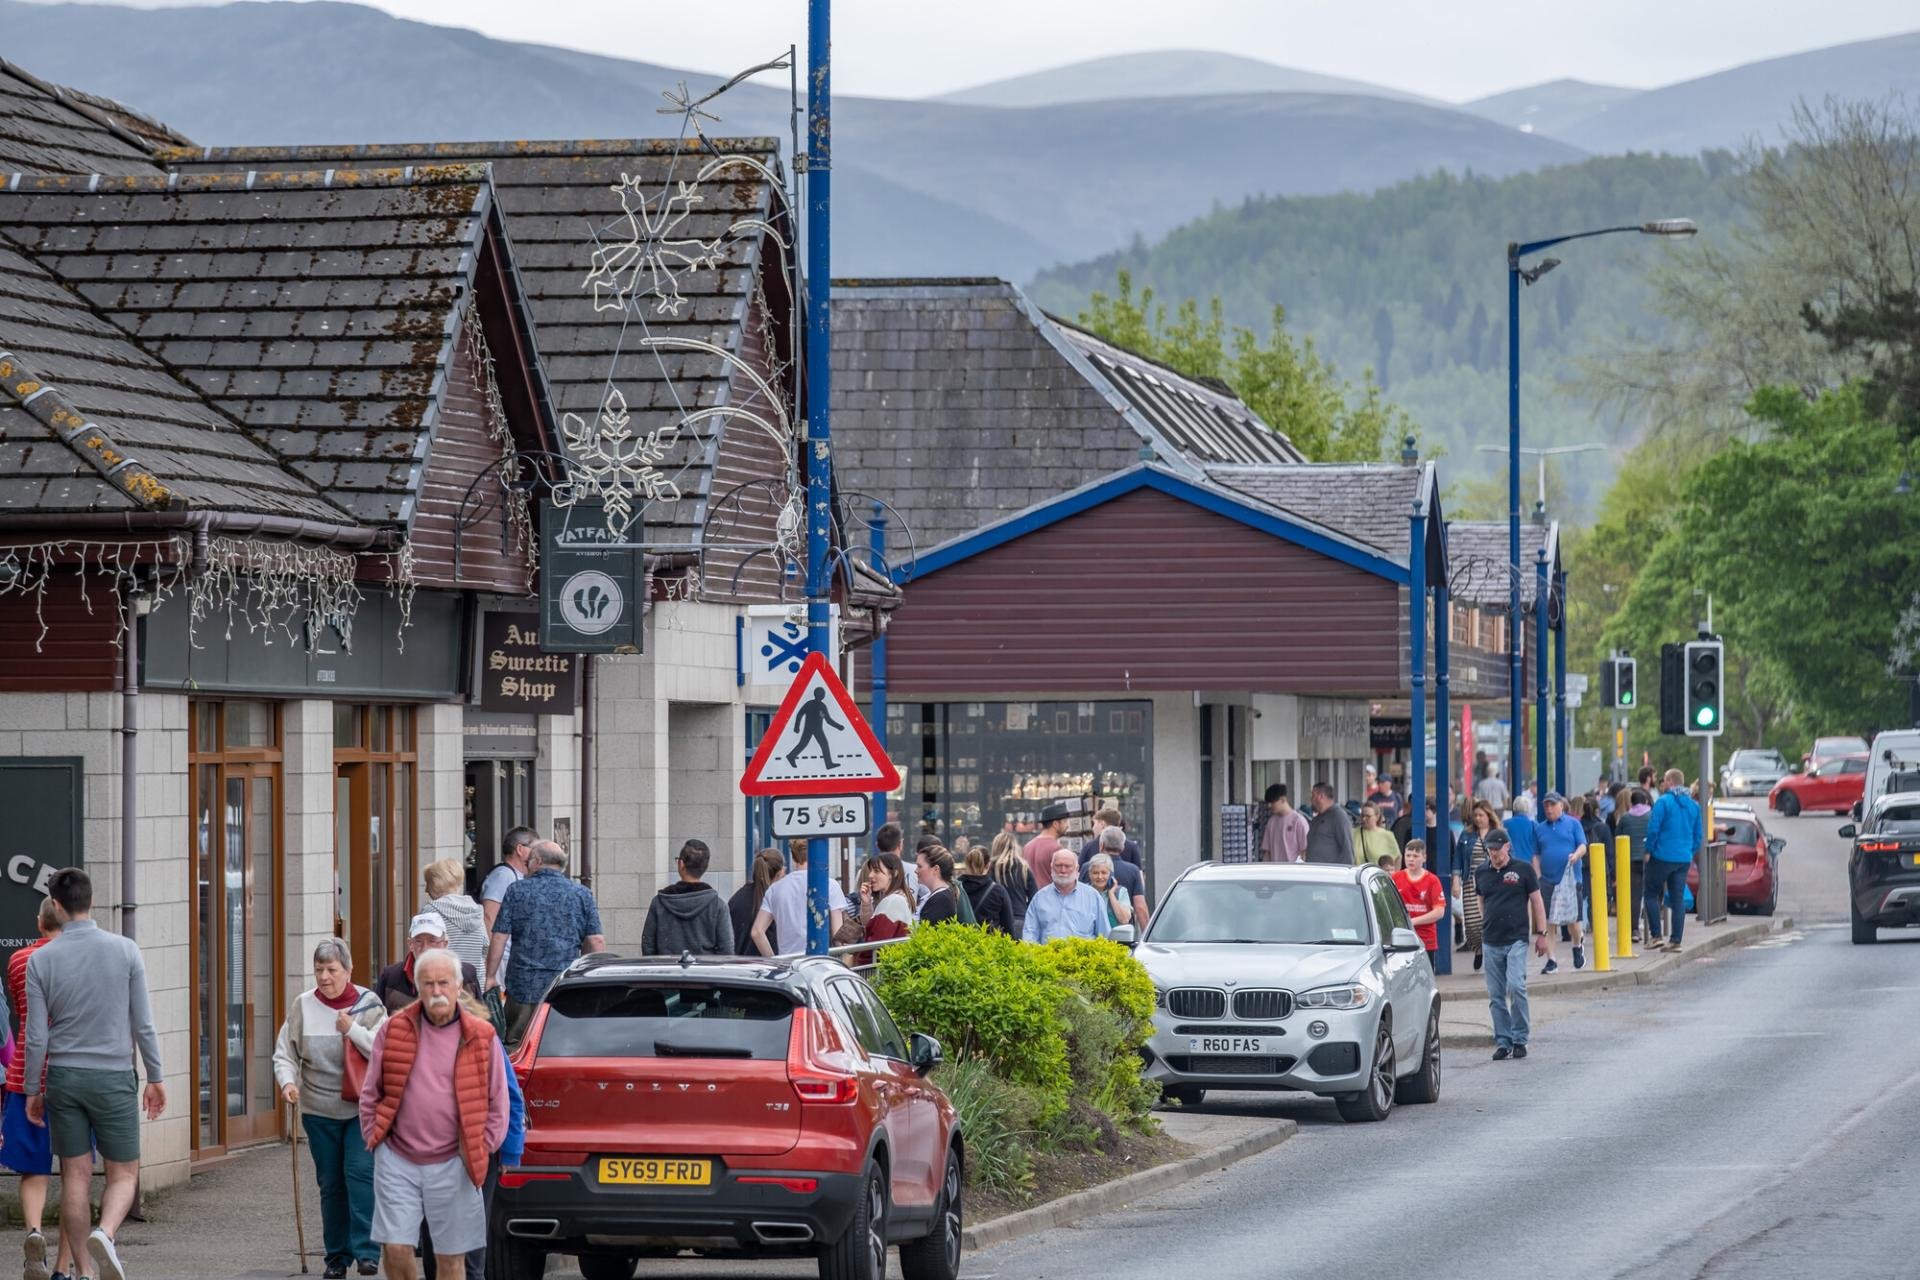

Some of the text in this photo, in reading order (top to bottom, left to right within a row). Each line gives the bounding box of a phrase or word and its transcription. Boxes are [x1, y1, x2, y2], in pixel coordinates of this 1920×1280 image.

[554, 527, 629, 544] FATFAE
[503, 624, 540, 645] Au
[488, 649, 570, 673] Sweetie
[500, 676, 557, 702] Shop
[782, 807, 810, 825] 75
[0, 854, 59, 896] CE
[0, 938, 23, 947] ORN
[1203, 1039, 1260, 1051] R60 FAS
[597, 1082, 717, 1092] VOLVO
[607, 1160, 702, 1180] SY69 FRD
